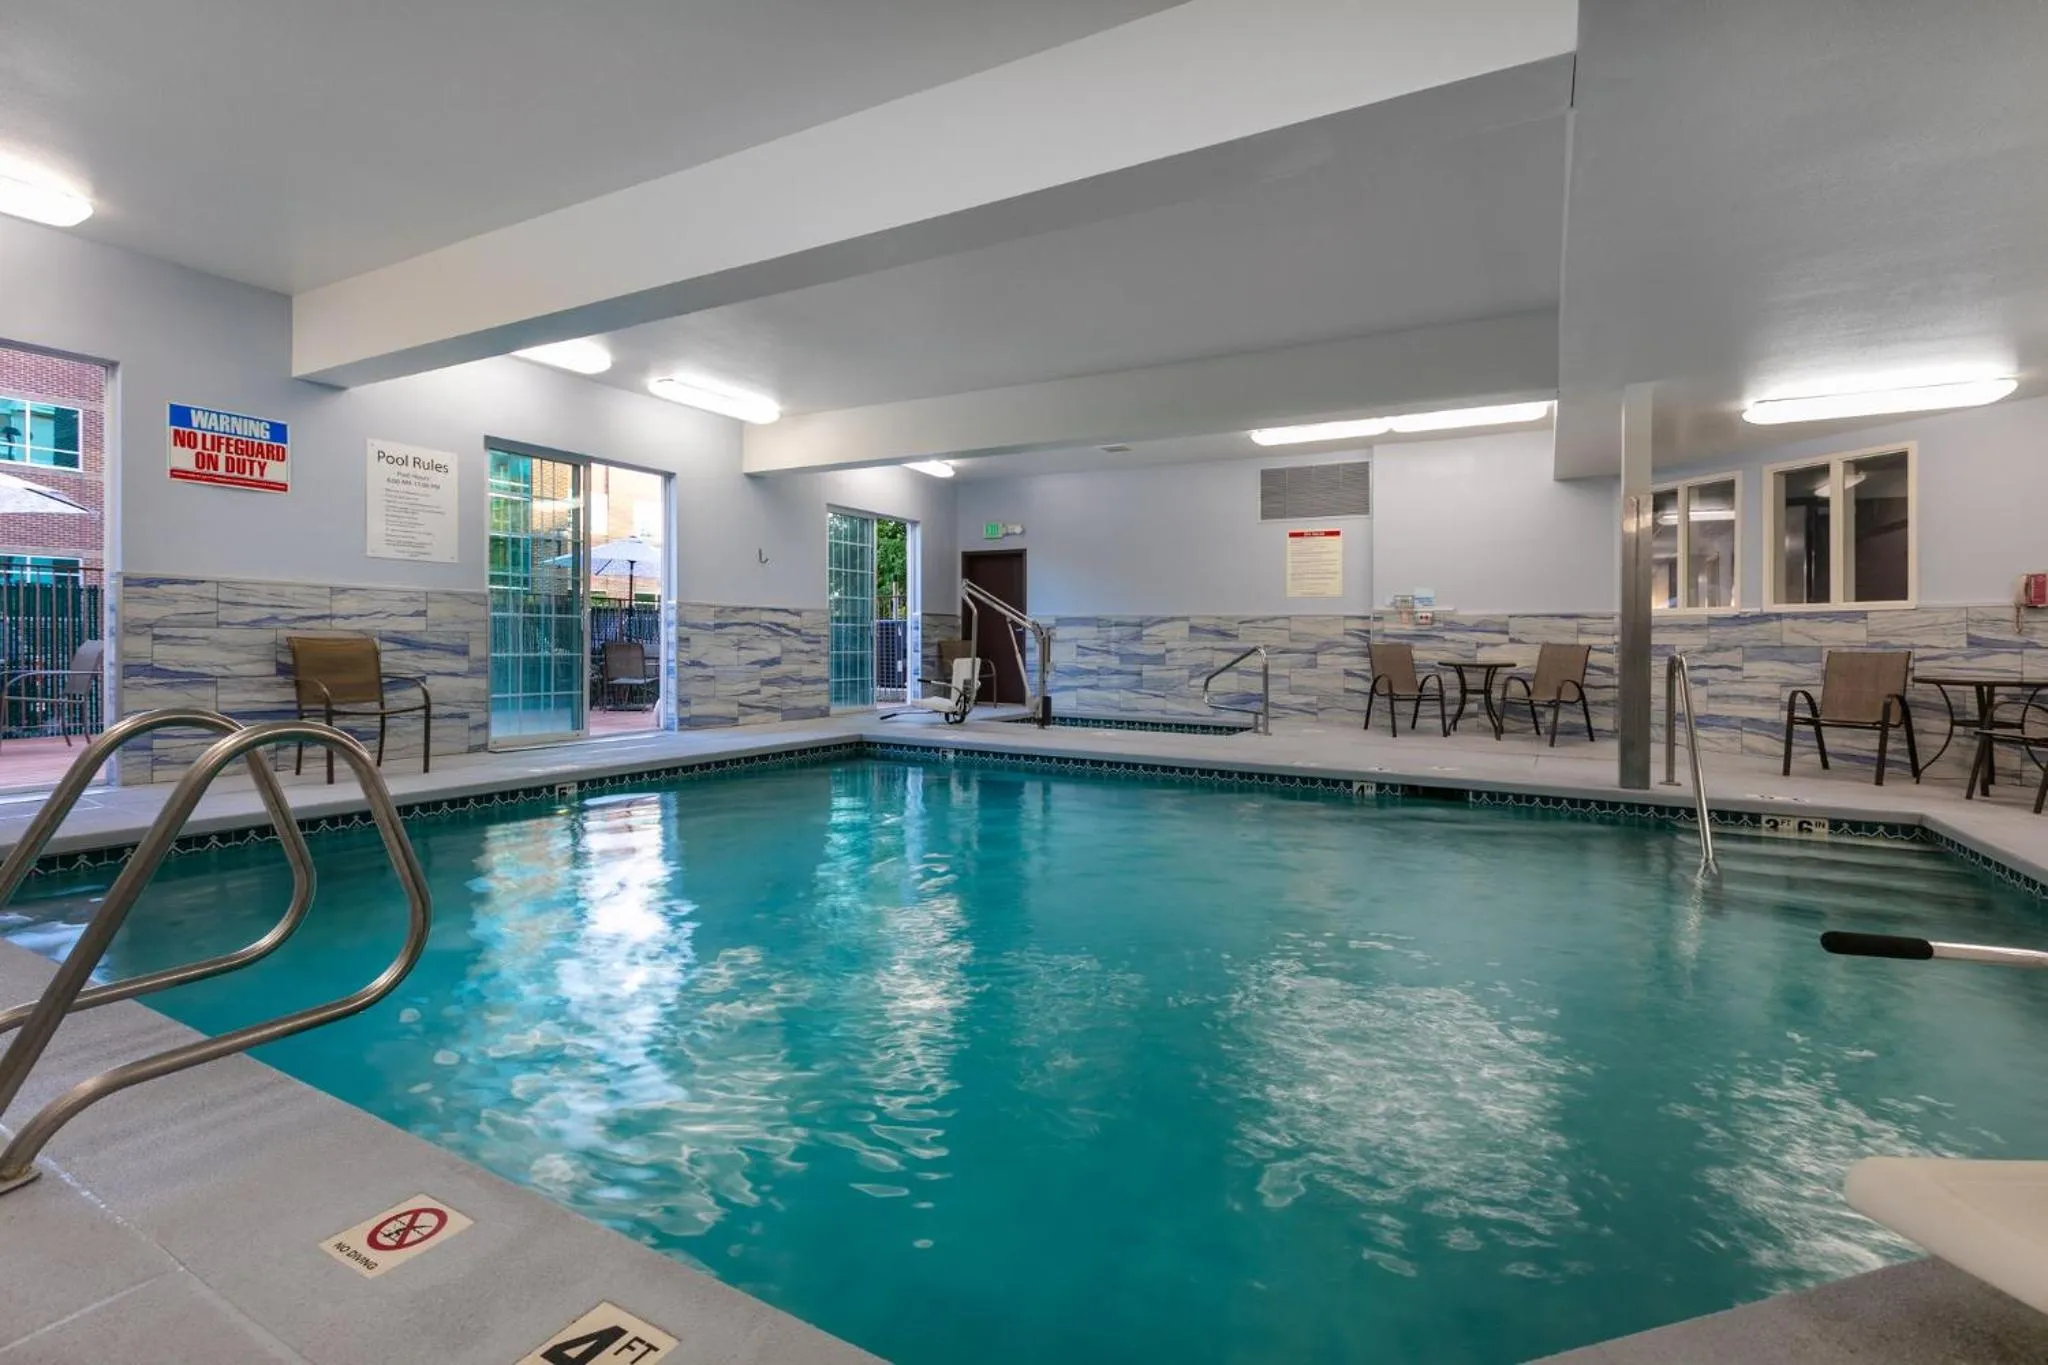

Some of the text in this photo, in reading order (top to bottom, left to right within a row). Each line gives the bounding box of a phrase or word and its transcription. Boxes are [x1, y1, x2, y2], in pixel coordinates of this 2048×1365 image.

[191, 408, 270, 440] WARNING
[173, 429, 286, 462] NO LIFEGUARD
[195, 451, 267, 477] ON DUTY
[377, 450, 449, 474] Pool Rules
[334, 1241, 378, 1271] NO DIVING
[540, 1324, 661, 1365] 4 FT
